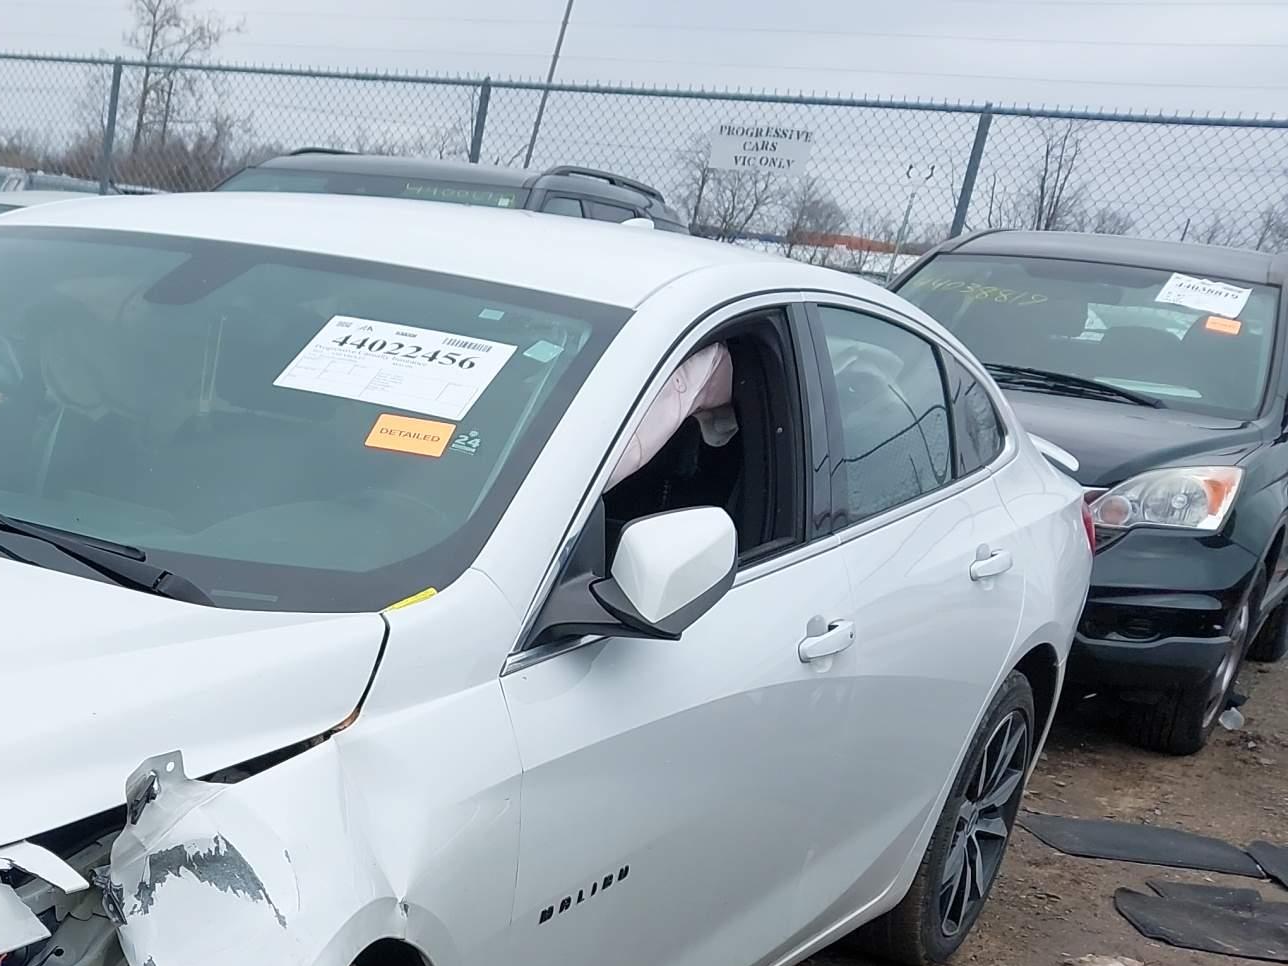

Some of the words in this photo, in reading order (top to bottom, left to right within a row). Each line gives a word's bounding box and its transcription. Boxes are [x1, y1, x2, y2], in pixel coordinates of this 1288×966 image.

[719, 125, 813, 143] PROGRESSIVE
[742, 141, 778, 152] CARS
[734, 155, 757, 167] VIC
[759, 156, 794, 169] ONLY
[332, 334, 481, 370] 44022456
[379, 427, 441, 442] DETAILED
[455, 434, 481, 447] 24
[539, 865, 629, 925] MALIBU
